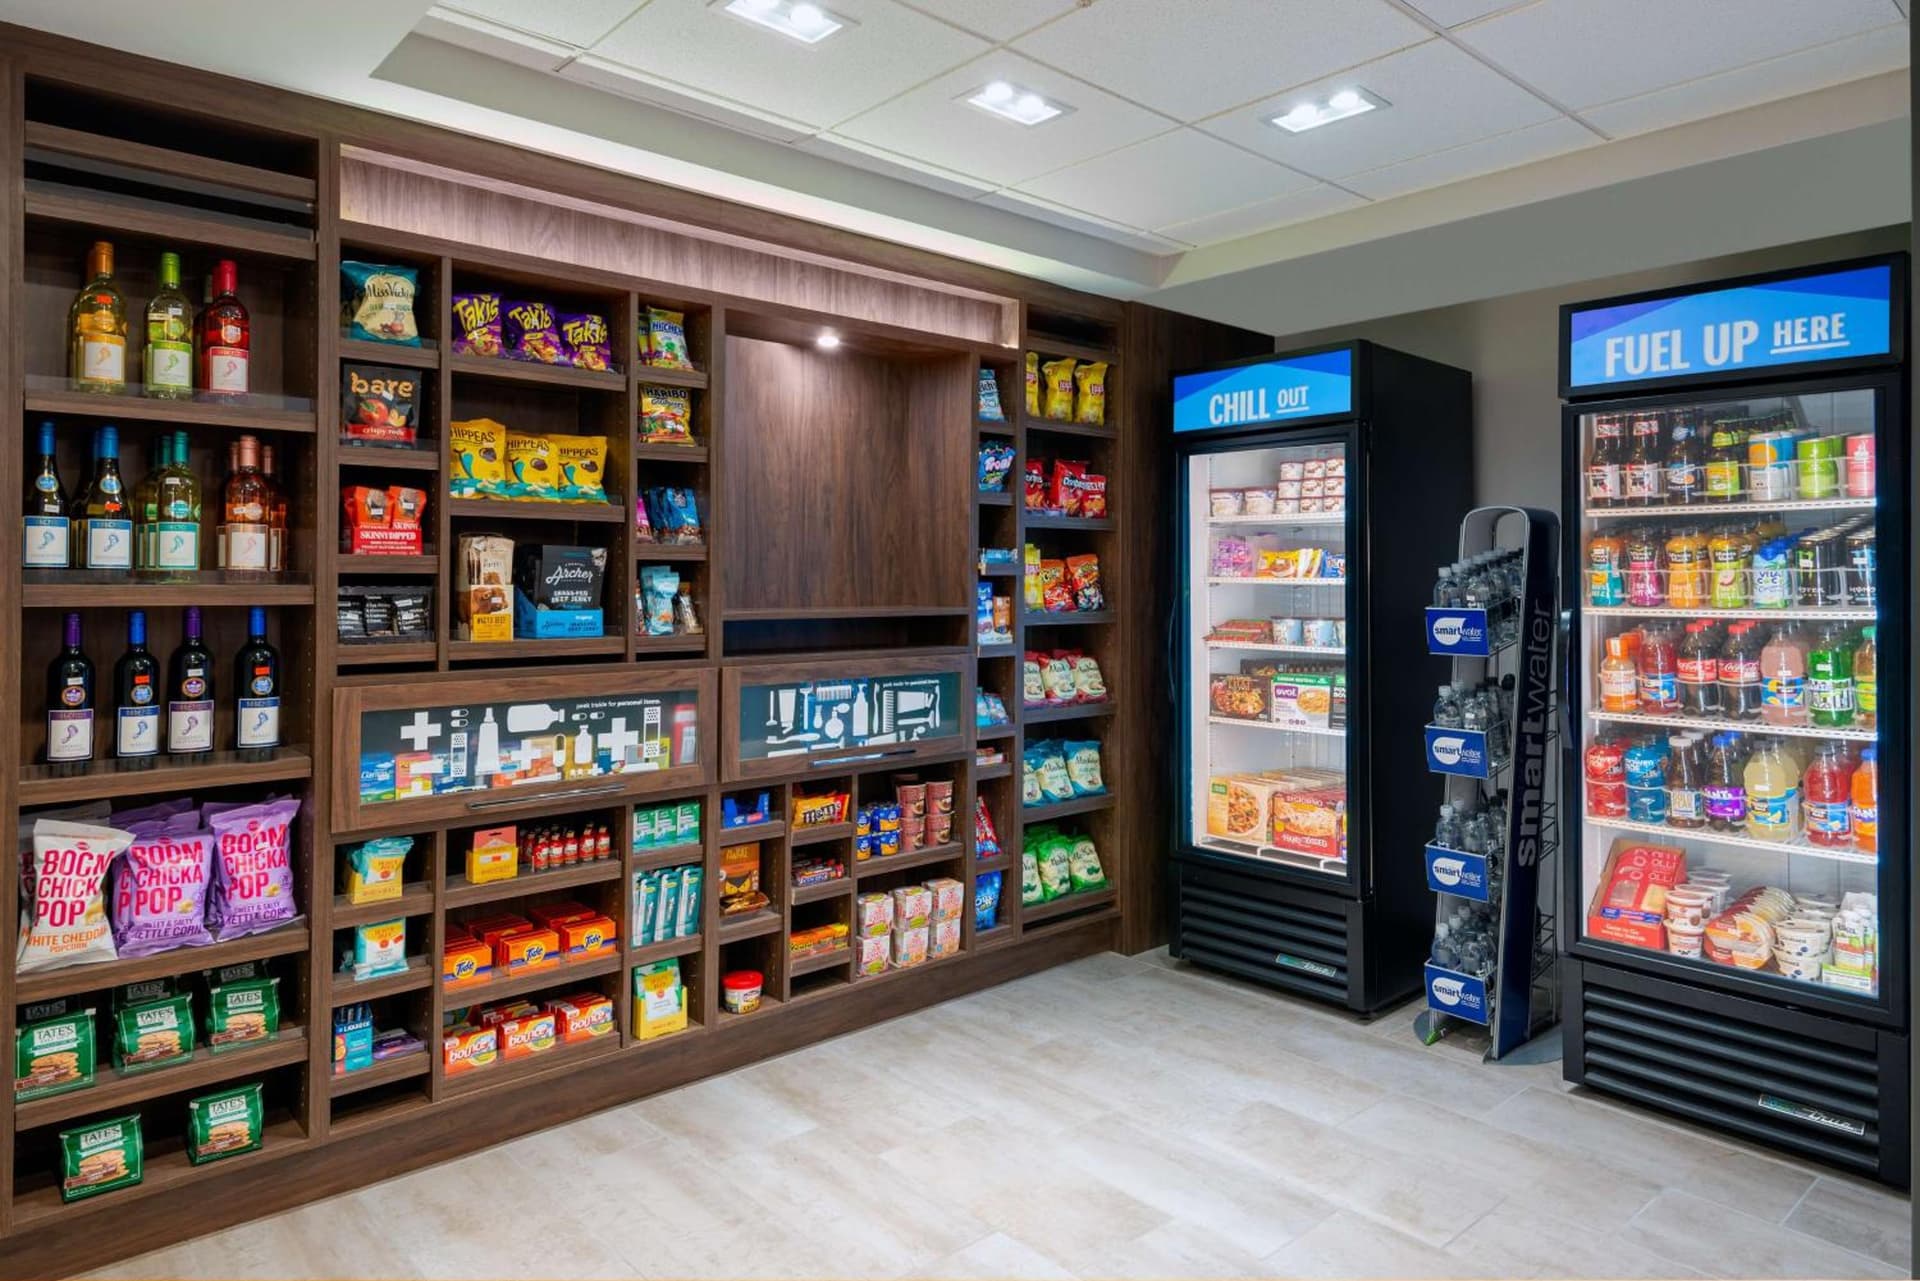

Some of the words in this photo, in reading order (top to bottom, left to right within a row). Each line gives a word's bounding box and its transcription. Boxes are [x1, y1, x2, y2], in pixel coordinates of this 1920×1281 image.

[453, 296, 499, 334] Takis
[508, 304, 552, 331] Takis
[563, 319, 607, 348] Takis
[1605, 330, 1690, 377] FUEL
[1703, 320, 1759, 367] UP
[1773, 312, 1846, 347] HERE
[351, 372, 413, 398] bare
[646, 388, 687, 400] HARIBO
[1209, 388, 1270, 425] CHILL
[1277, 386, 1309, 408] OUT
[450, 426, 495, 444] HIPPEAS
[545, 565, 594, 586] Archer
[1518, 603, 1551, 868] smartwater
[222, 824, 287, 856] BOOM
[132, 841, 203, 869] BOOM
[223, 852, 288, 877] CHICKA
[136, 864, 203, 888] CHICKA
[228, 872, 270, 901] POP
[135, 886, 182, 917] POP
[34, 900, 86, 927] POP
[172, 924, 202, 938] CORN
[584, 934, 601, 947] Tide
[525, 947, 543, 960] Tide
[456, 961, 475, 976] Tide
[230, 992, 261, 1003] TATE'S
[138, 1008, 173, 1021] TATE'S
[570, 1012, 608, 1032] bounce
[37, 1024, 74, 1040] TATE'S
[509, 1028, 548, 1049] bounce
[449, 1043, 489, 1064] bounce
[210, 1097, 246, 1112] TATE'S
[83, 1126, 121, 1142] TATE'S
